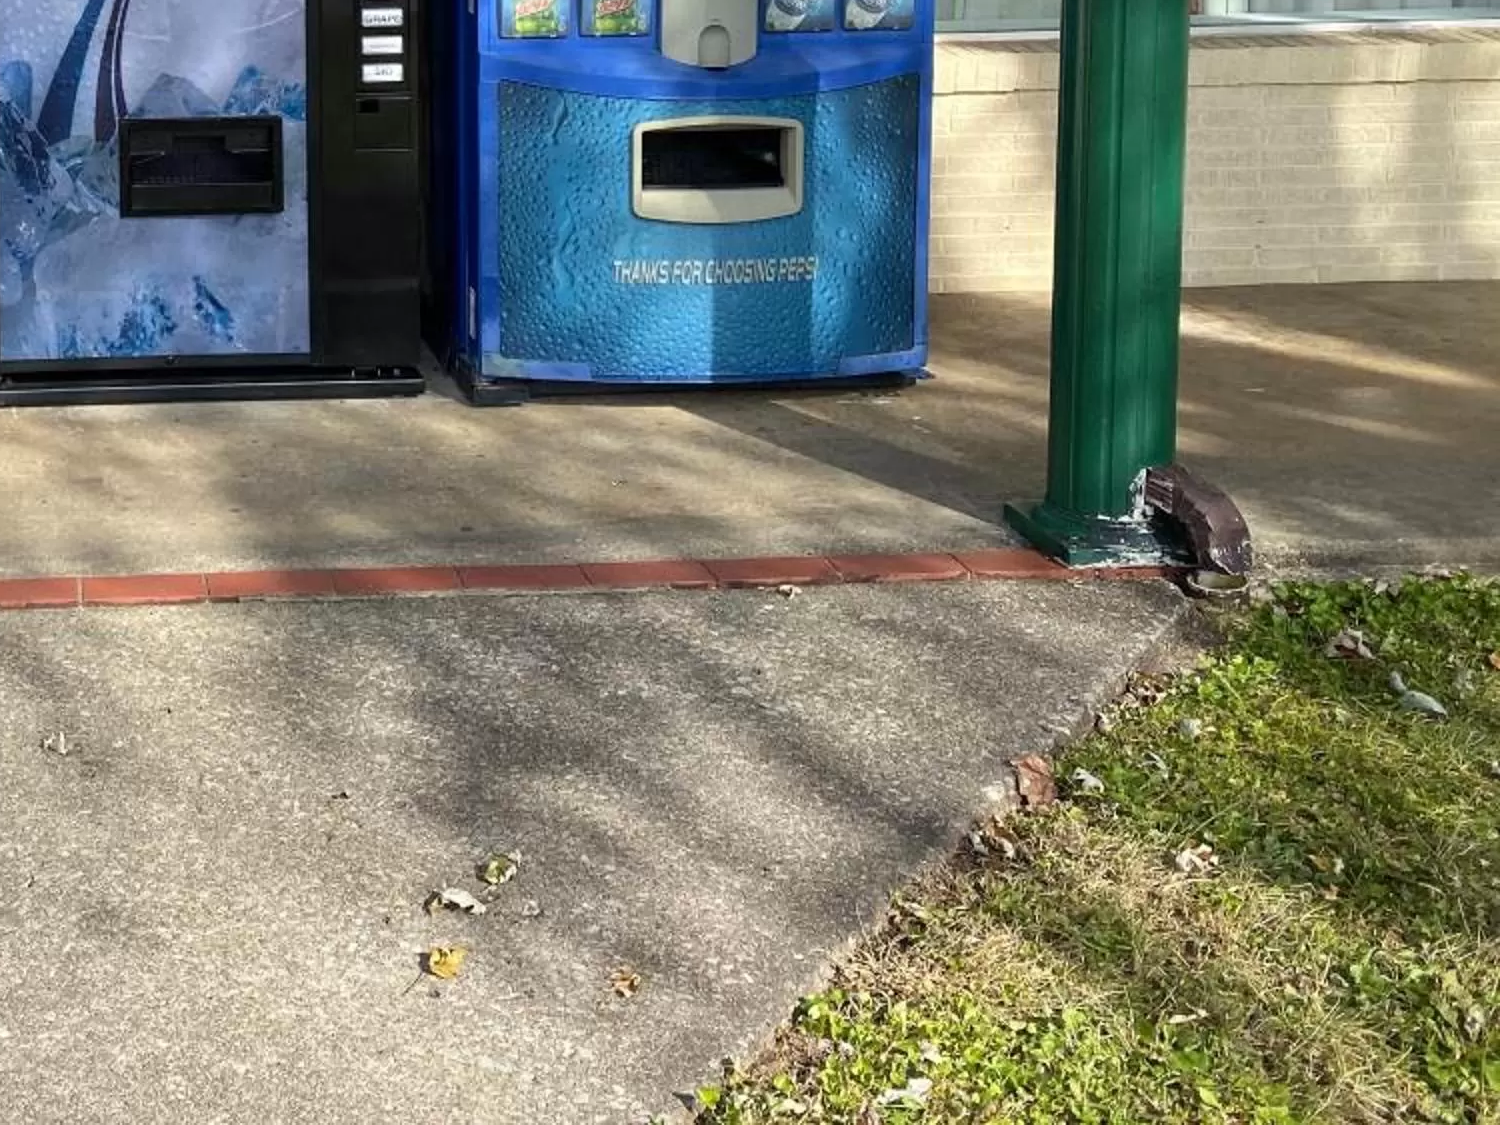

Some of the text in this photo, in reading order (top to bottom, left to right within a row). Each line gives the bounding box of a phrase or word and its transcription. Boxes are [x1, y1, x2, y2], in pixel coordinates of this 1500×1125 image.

[613, 256, 819, 284] THANKS FOR CHOOSING PEPSI
